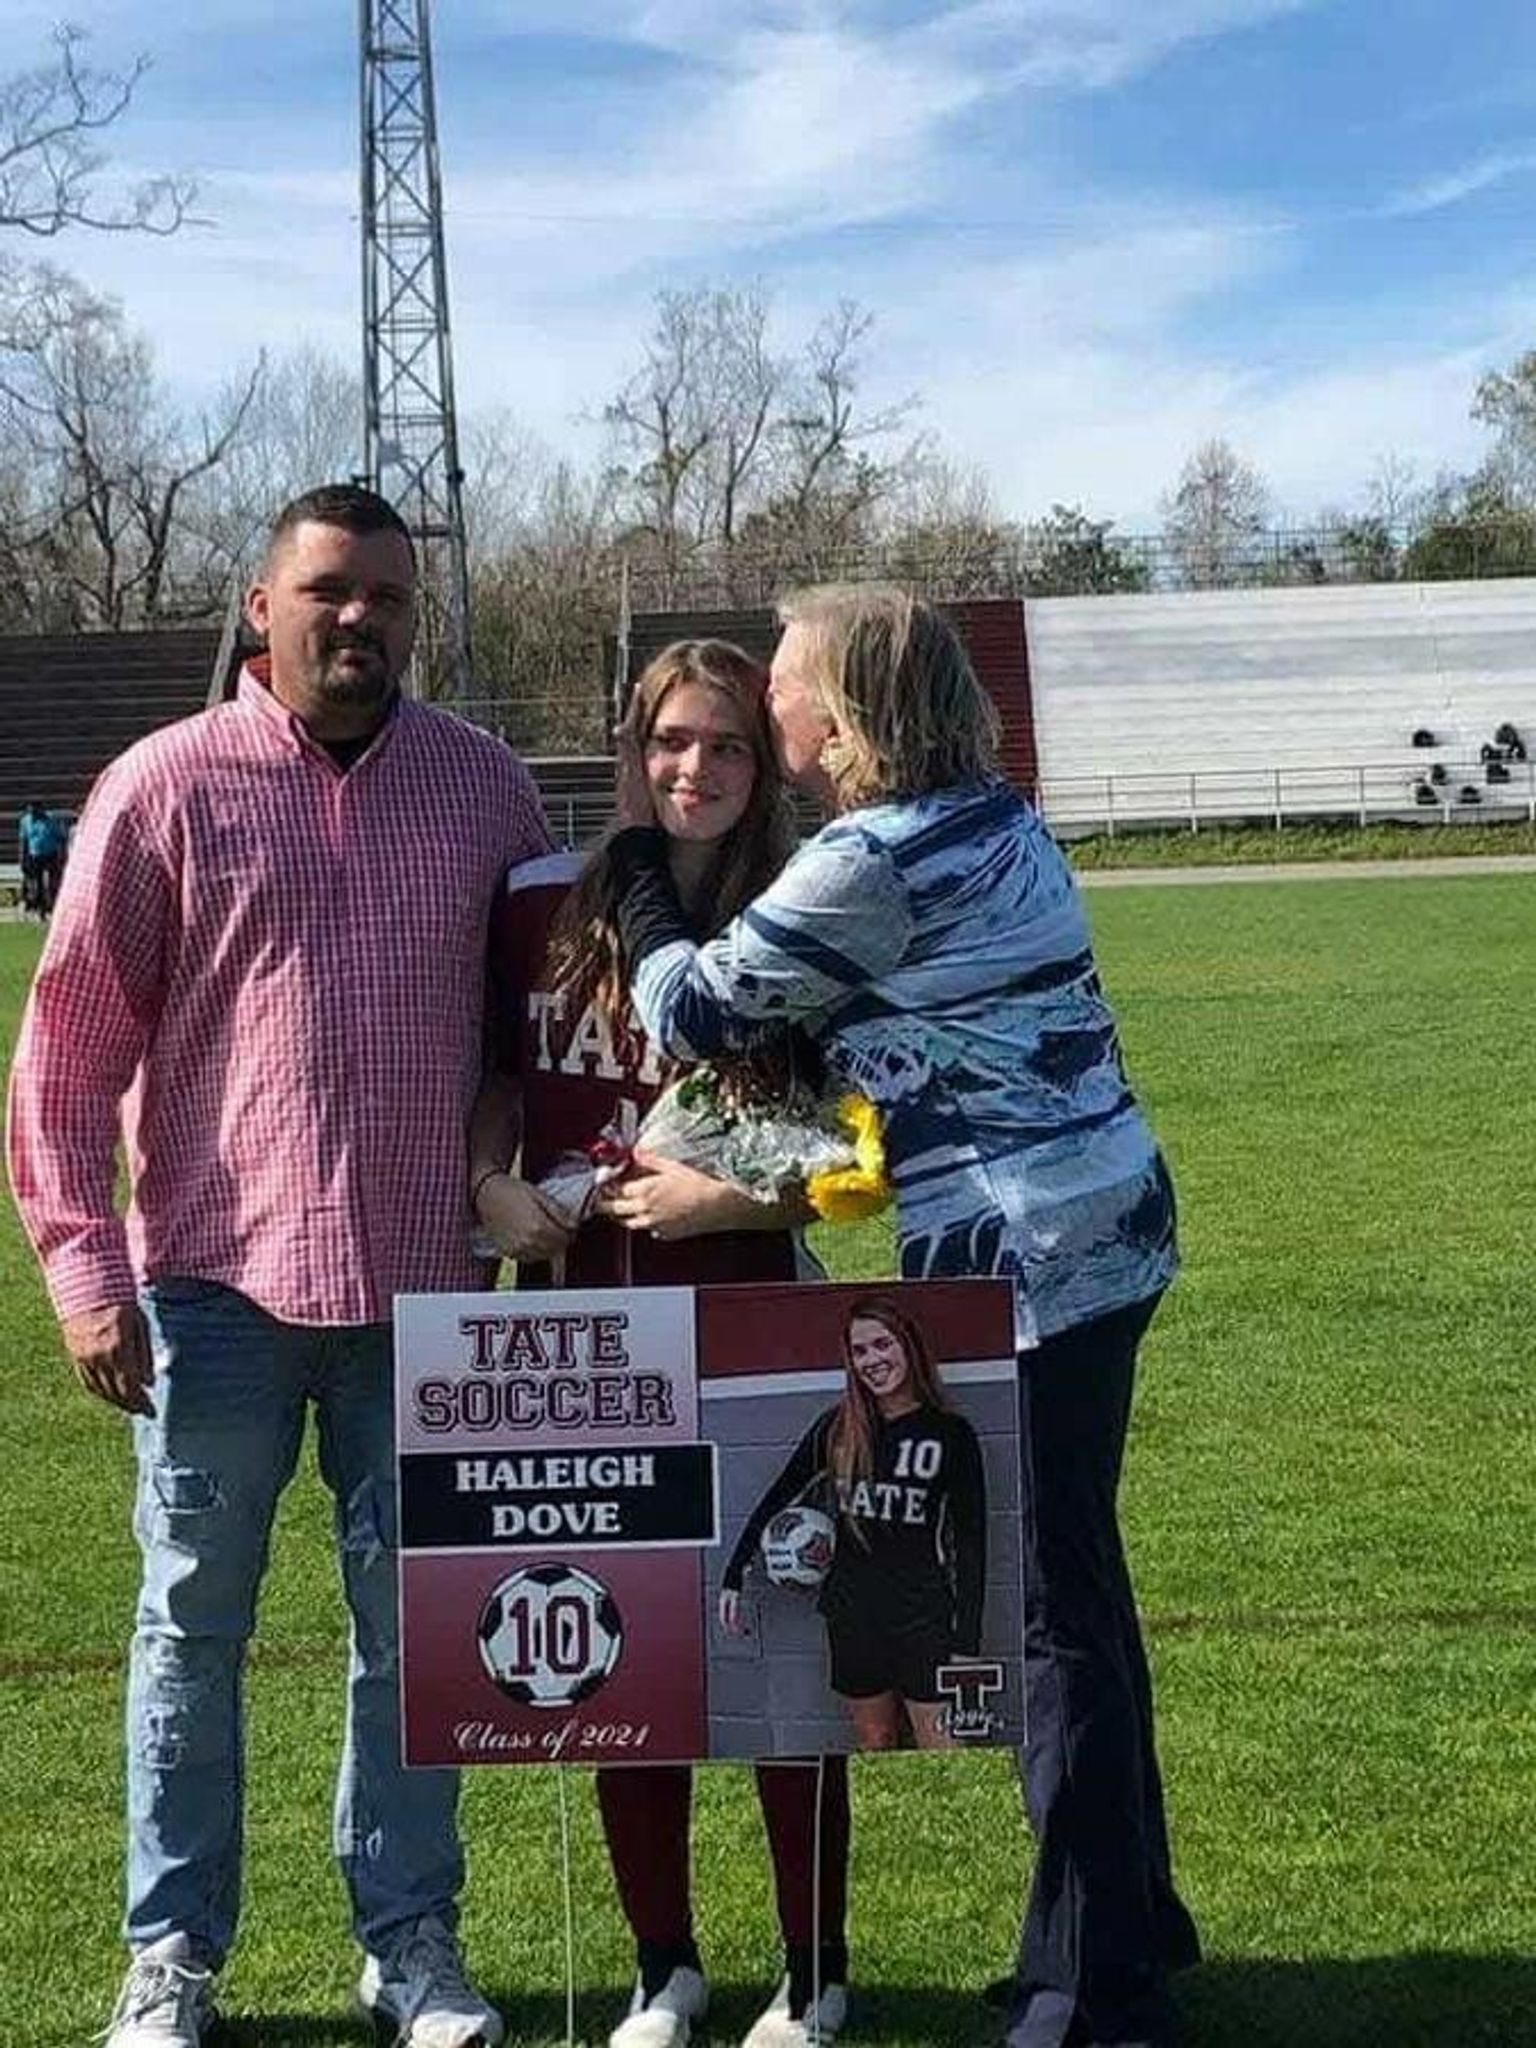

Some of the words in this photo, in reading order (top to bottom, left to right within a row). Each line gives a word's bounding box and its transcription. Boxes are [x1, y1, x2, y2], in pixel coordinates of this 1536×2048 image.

[459, 1311, 630, 1372] TATE
[413, 1370, 677, 1433] SOCCER
[455, 1453, 656, 1492] HALEIGH
[893, 1438, 943, 1479] 10
[491, 1502, 623, 1538] DOVE
[508, 1595, 592, 1676] 10
[451, 1719, 532, 1751] Class
[540, 1717, 579, 1759] of
[579, 1722, 651, 1748] 2021
